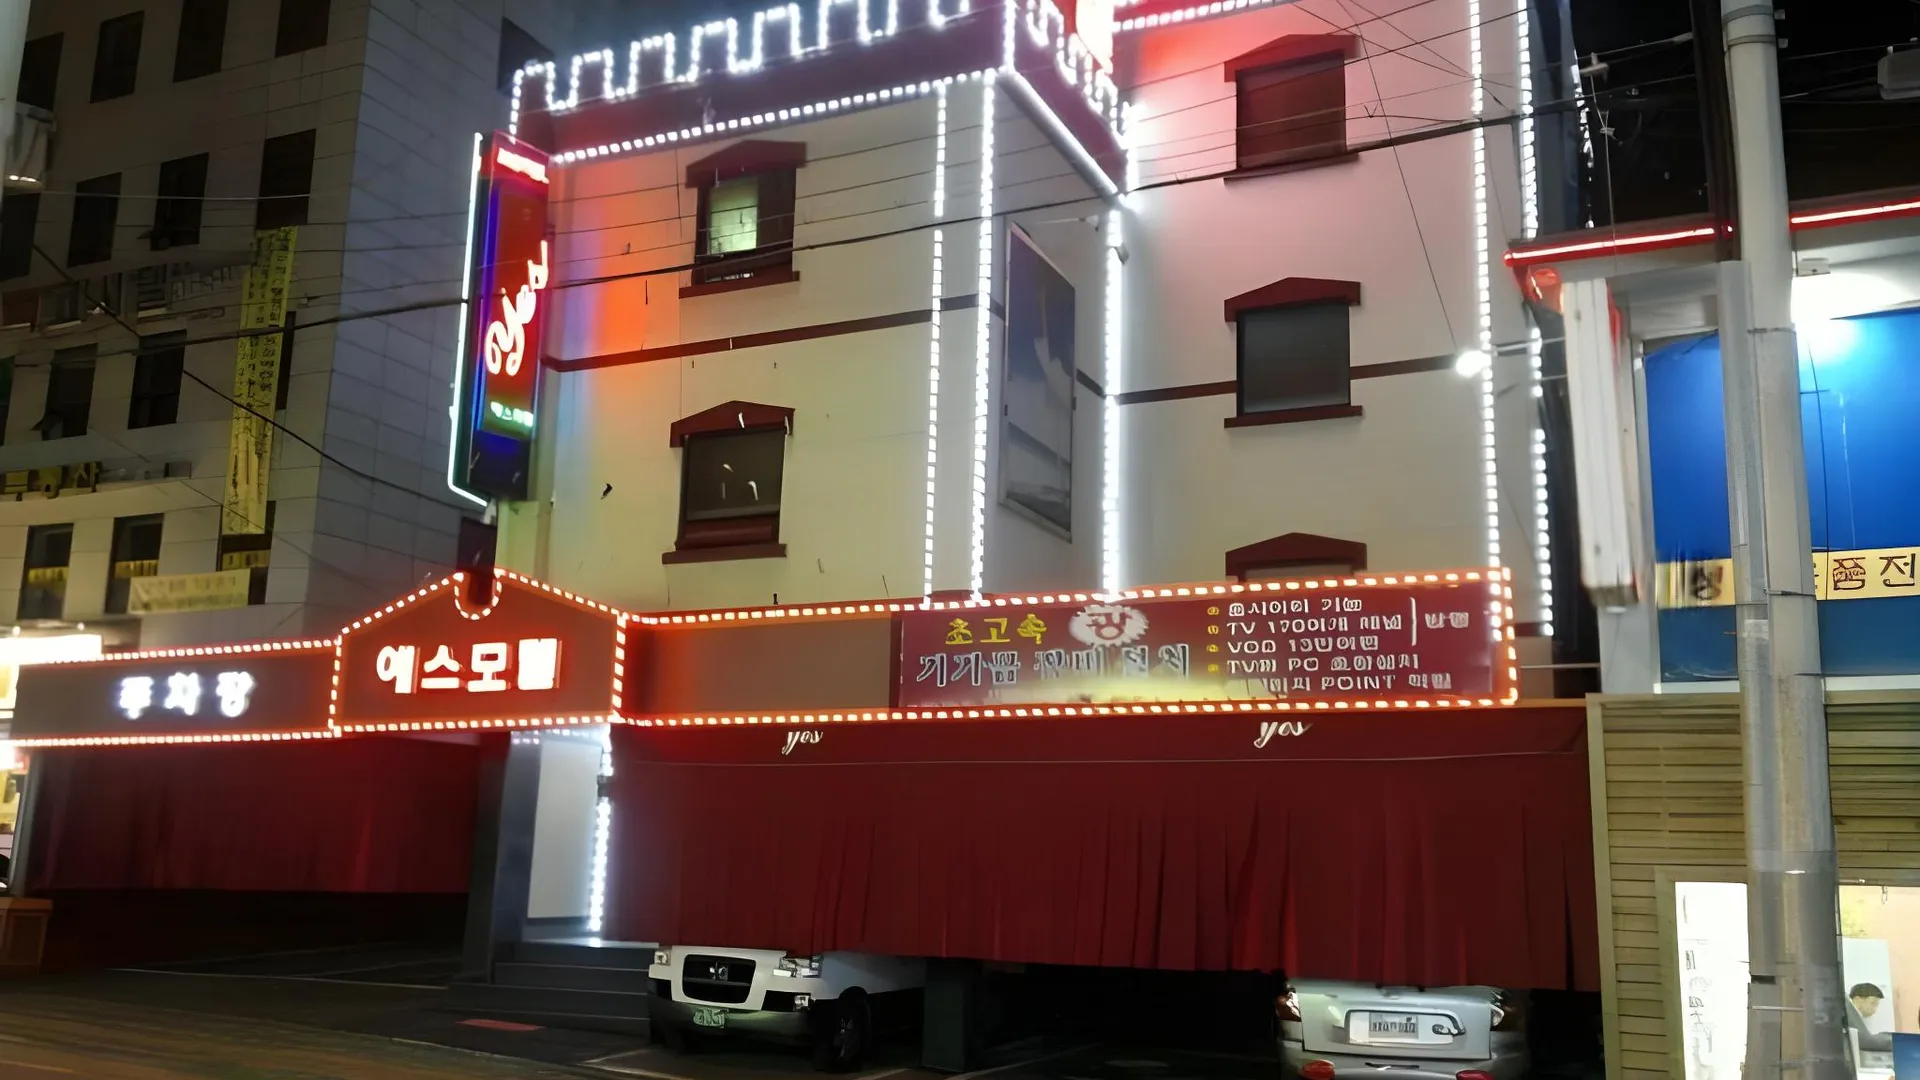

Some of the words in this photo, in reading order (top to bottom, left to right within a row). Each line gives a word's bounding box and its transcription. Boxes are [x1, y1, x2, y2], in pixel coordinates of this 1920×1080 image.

[945, 613, 1047, 645] 초고속
[1226, 621, 1255, 636] TV
[376, 638, 561, 694] 예스모
[1321, 674, 1396, 690] POINT
